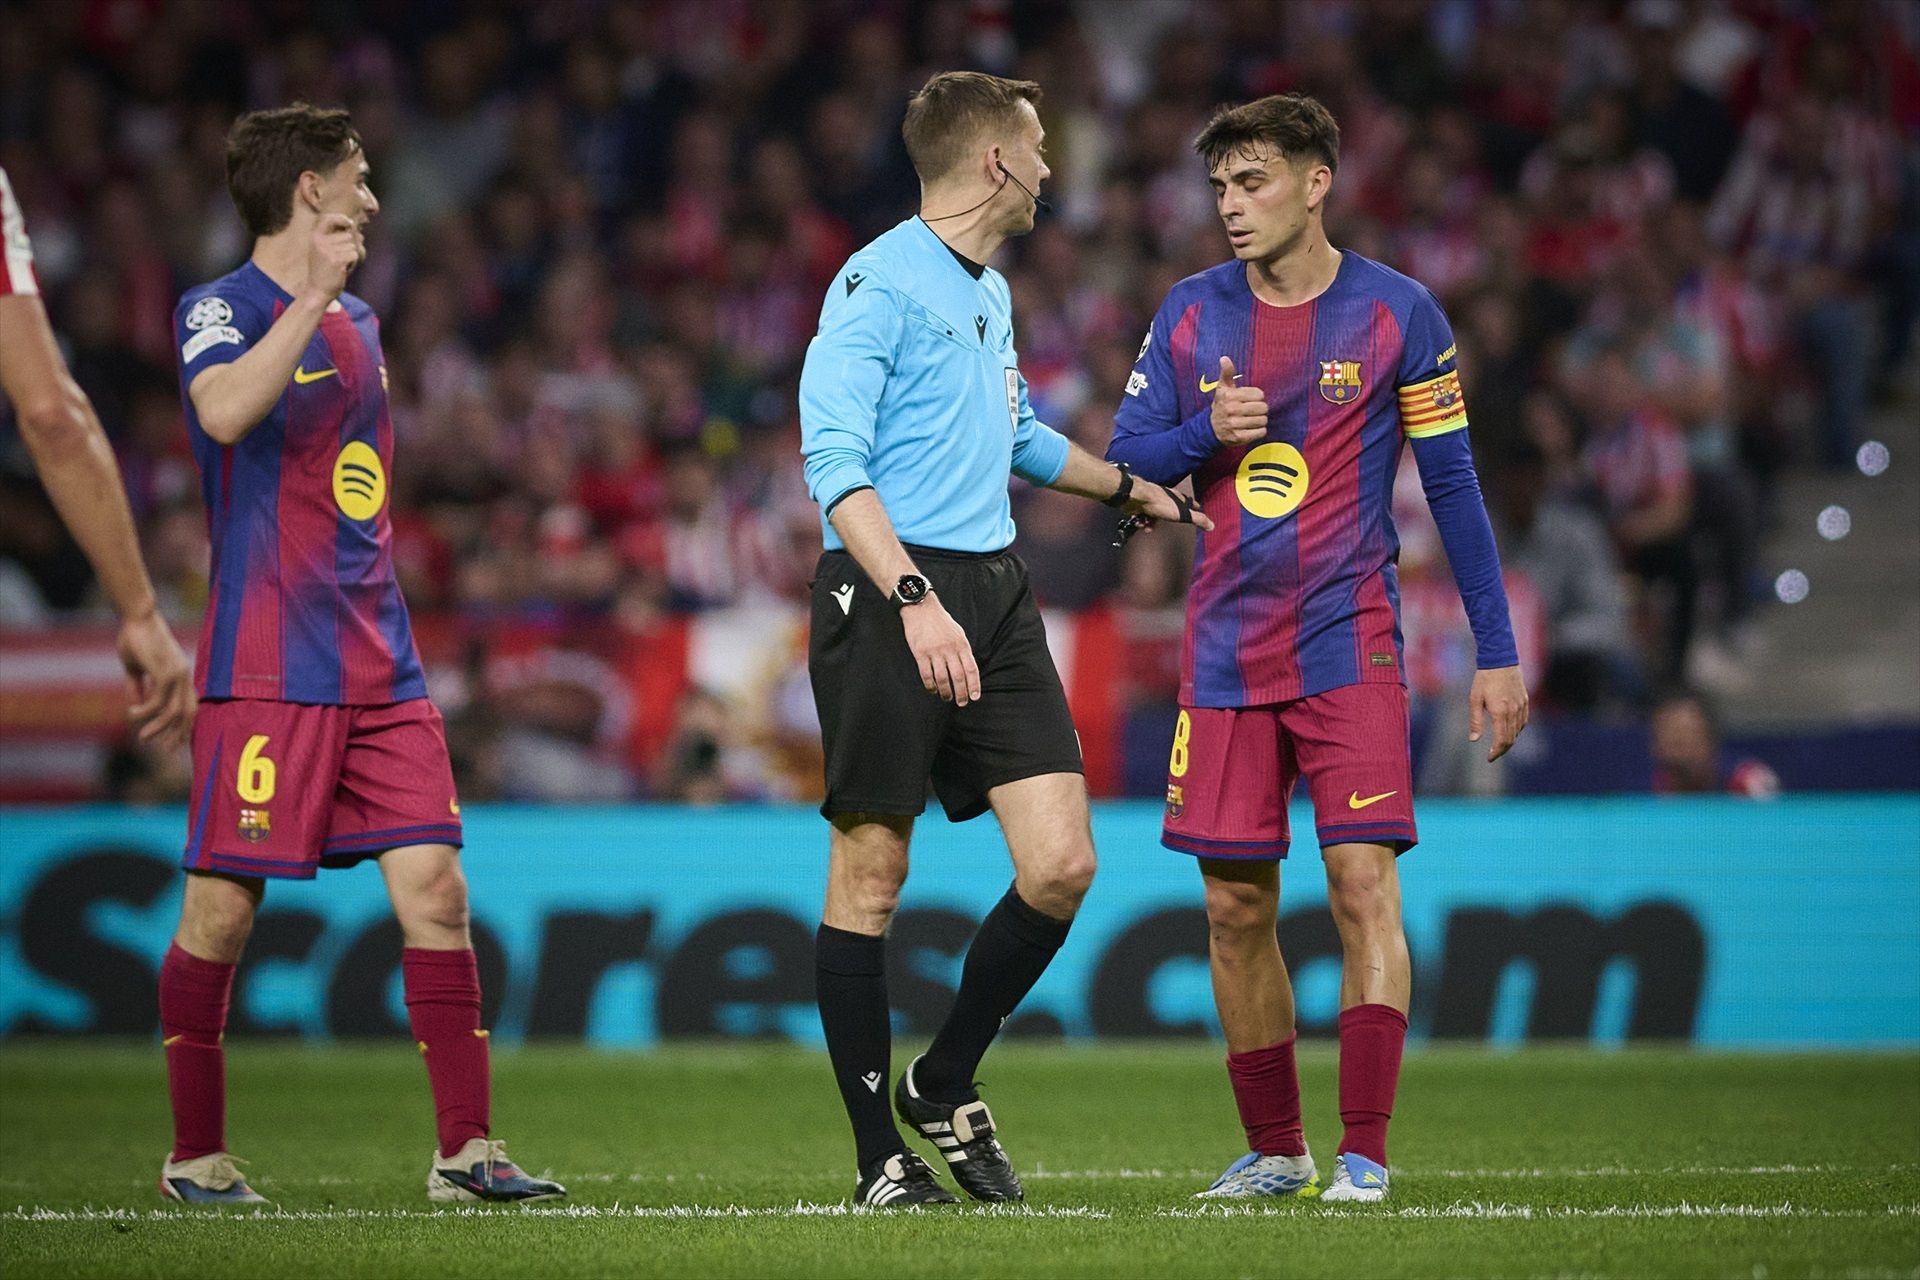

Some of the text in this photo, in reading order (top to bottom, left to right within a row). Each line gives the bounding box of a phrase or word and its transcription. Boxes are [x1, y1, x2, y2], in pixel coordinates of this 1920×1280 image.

[236, 734, 276, 804] 6
[1169, 709, 1191, 778] 8
[0, 847, 1707, 1038] Scores.com
